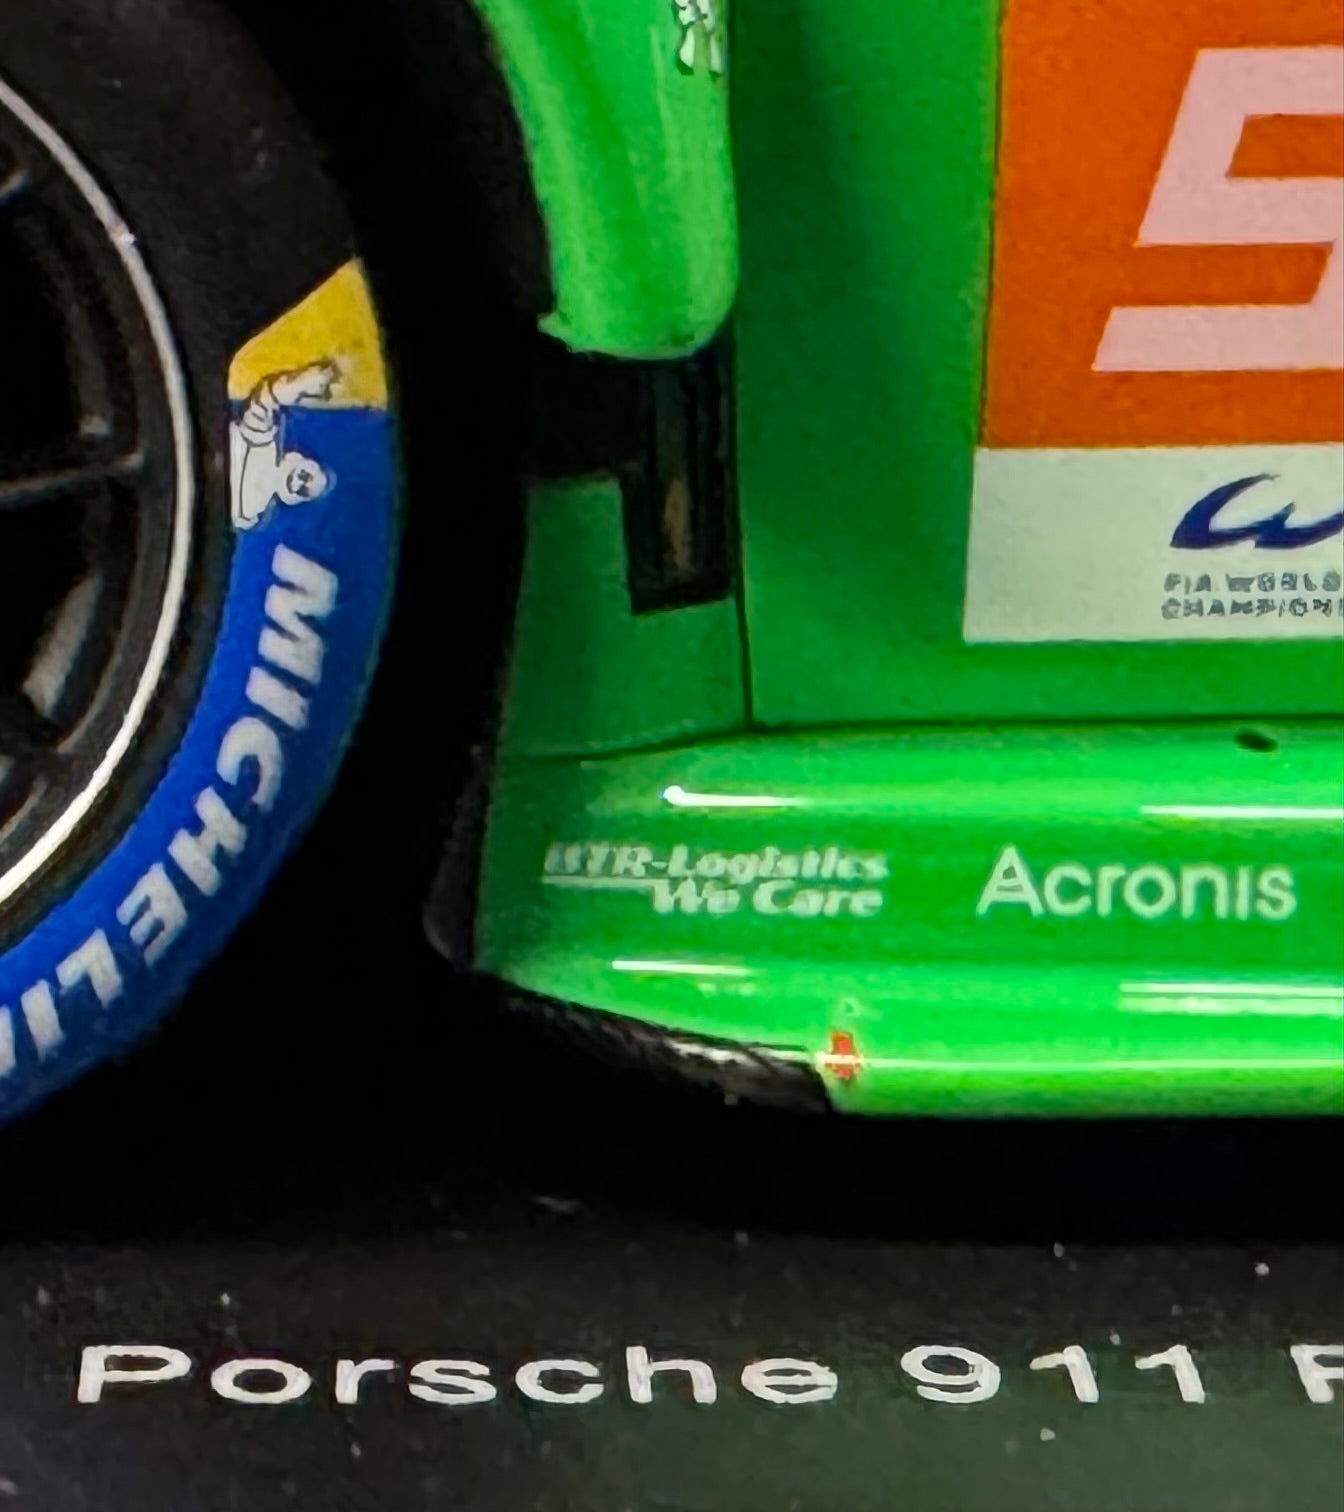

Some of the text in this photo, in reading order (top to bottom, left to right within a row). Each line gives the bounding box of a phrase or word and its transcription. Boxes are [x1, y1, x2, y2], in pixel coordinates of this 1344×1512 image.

[652, 879, 883, 916] We Care
[976, 844, 1298, 920] Acronis
[77, 1345, 1206, 1404] Porsche 911
